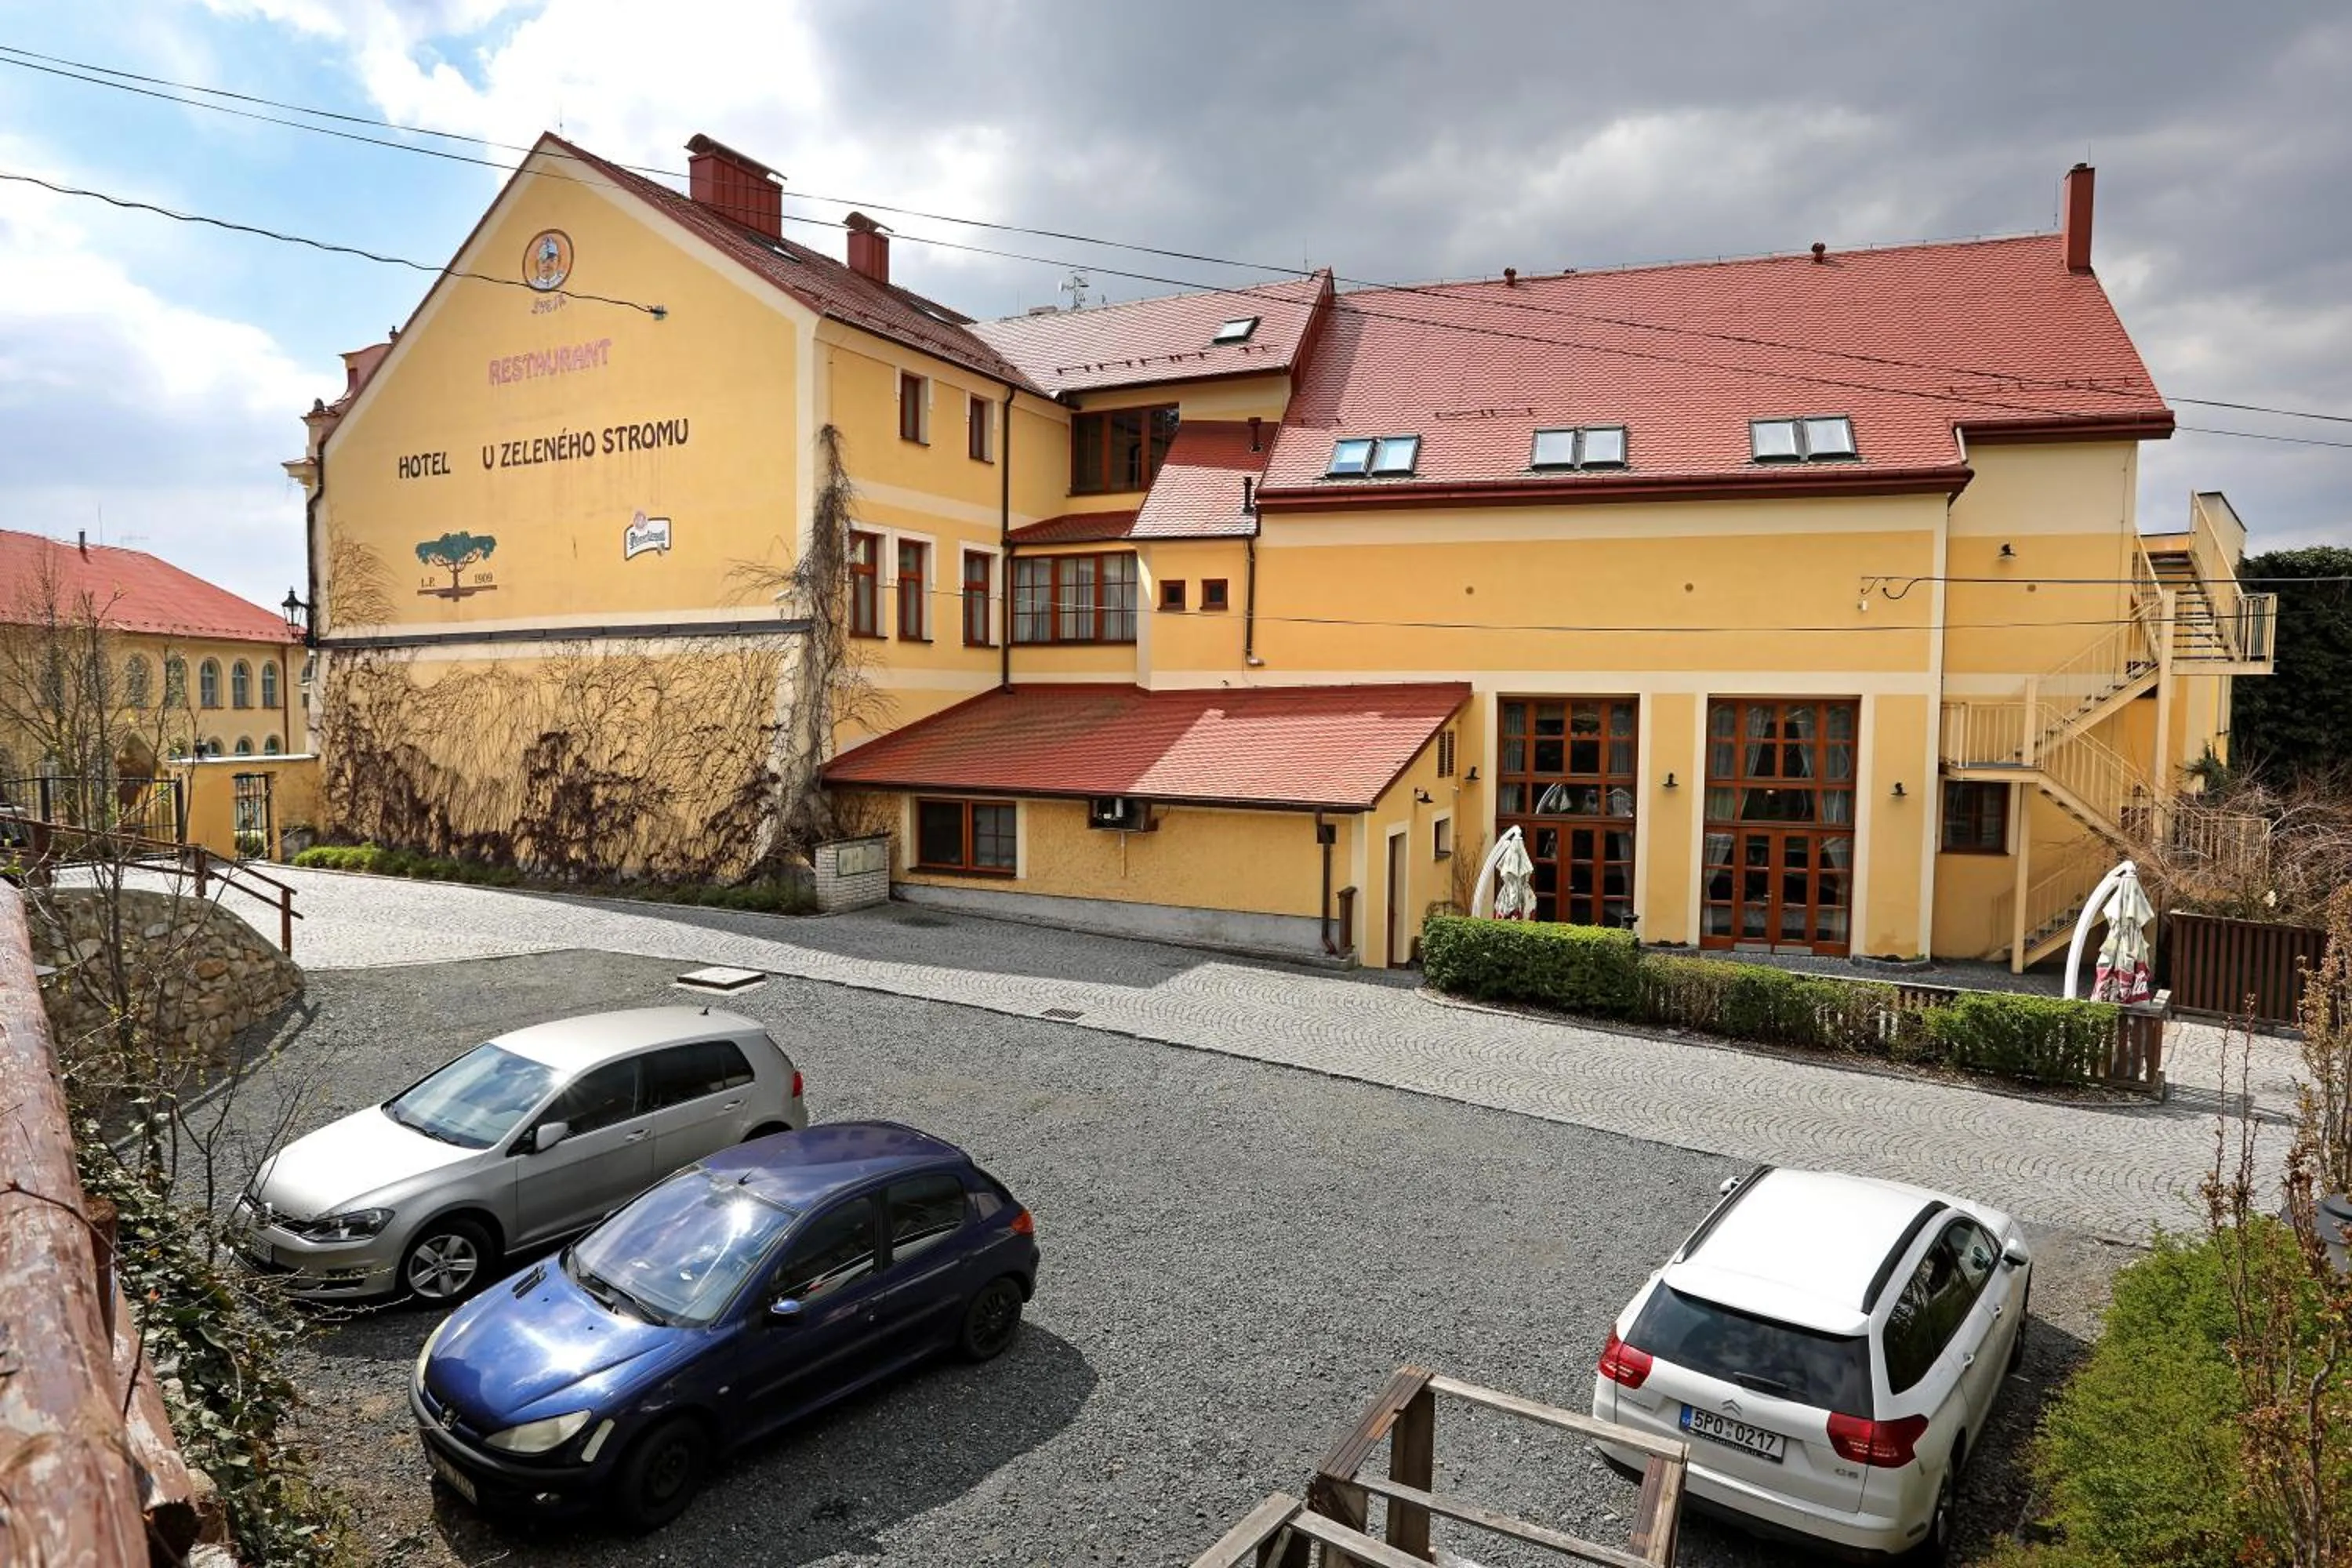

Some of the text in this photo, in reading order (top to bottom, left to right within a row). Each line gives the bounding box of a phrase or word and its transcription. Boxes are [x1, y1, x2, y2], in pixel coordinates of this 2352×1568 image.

[489, 338, 612, 386] RESTAURANT
[399, 418, 688, 479] HOTEL U ZELENÉHO STROMU
[1735, 1425, 1776, 1450] 0217
